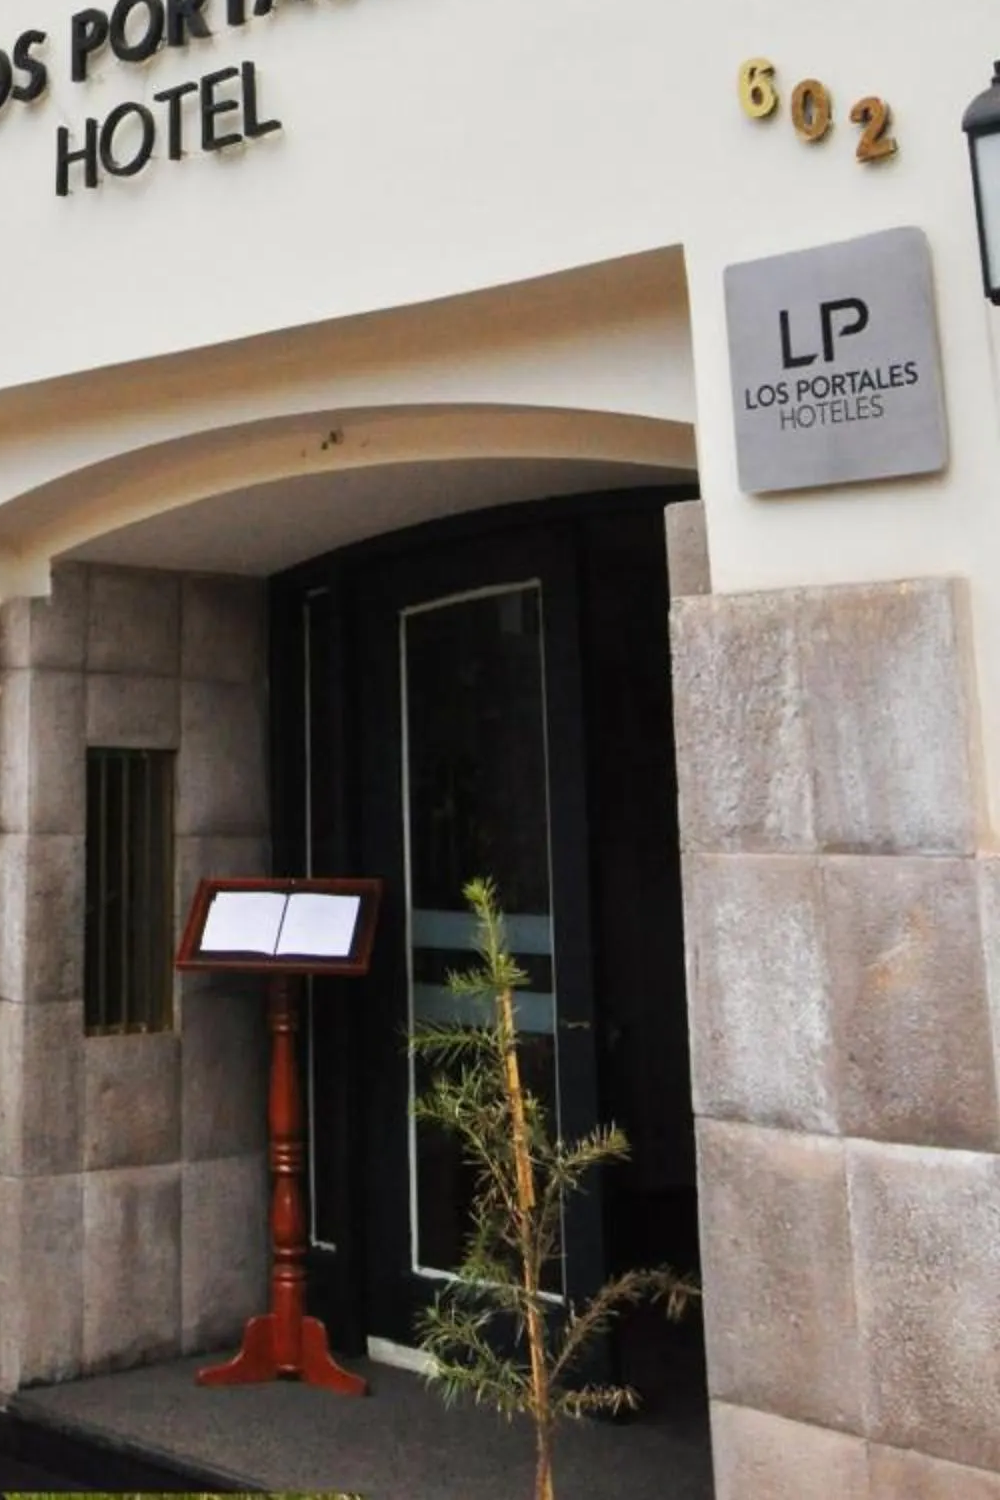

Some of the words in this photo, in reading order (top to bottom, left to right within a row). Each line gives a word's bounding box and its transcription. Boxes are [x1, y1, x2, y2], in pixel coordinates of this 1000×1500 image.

[56, 61, 281, 196] HOTEL
[738, 58, 897, 165] 602
[779, 298, 869, 369] LP
[745, 382, 790, 410] LOS
[796, 362, 919, 402] PORTALES
[779, 395, 885, 431] HOTELES
